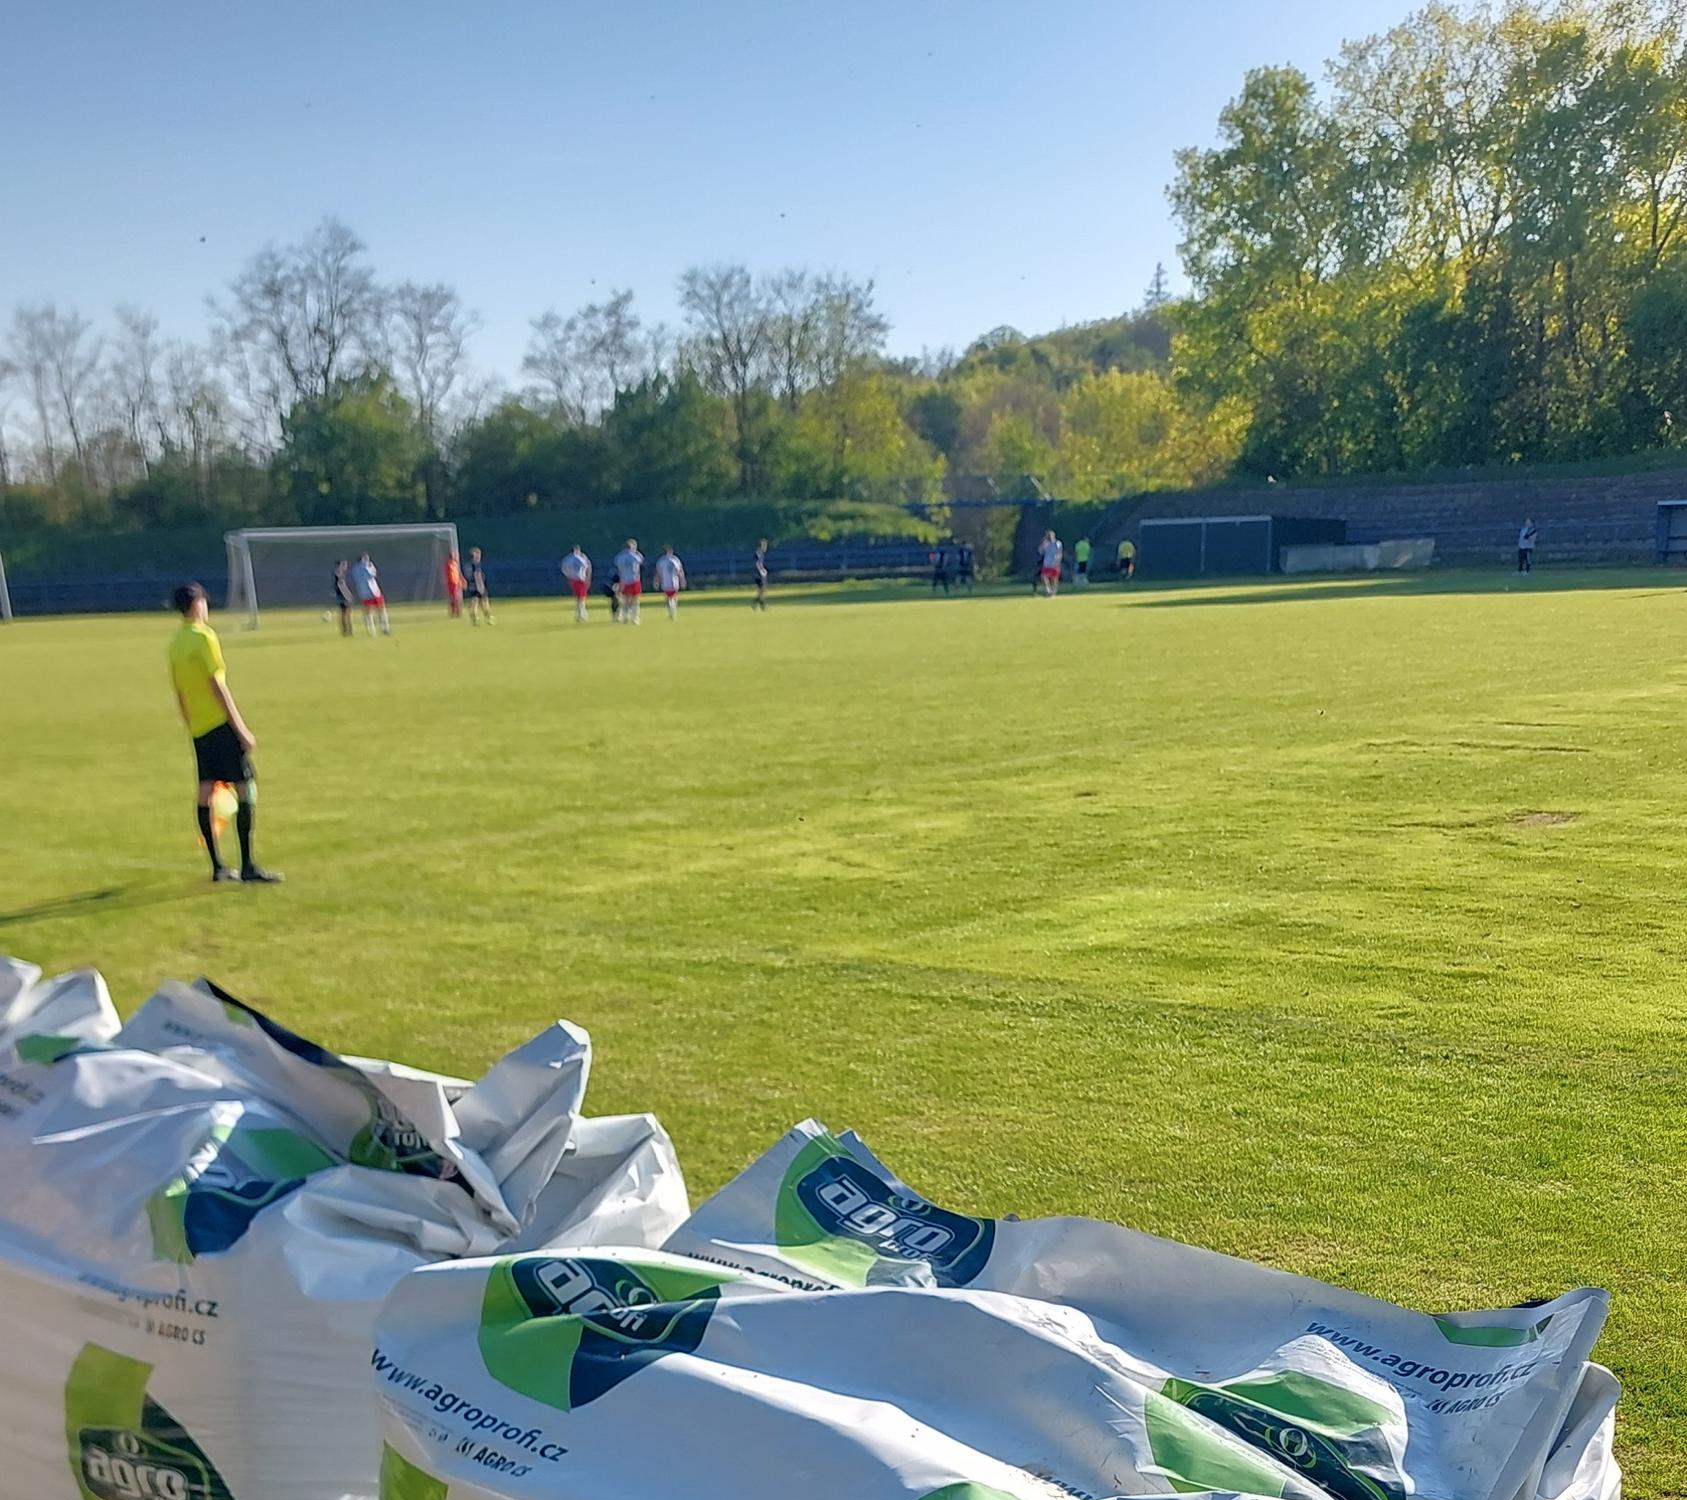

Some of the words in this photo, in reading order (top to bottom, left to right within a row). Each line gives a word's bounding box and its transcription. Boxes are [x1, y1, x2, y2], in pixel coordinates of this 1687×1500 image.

[820, 1177, 953, 1252] agro
[371, 1348, 569, 1462] www.agroprofi.cz
[1447, 1396, 1486, 1415] AGRO
